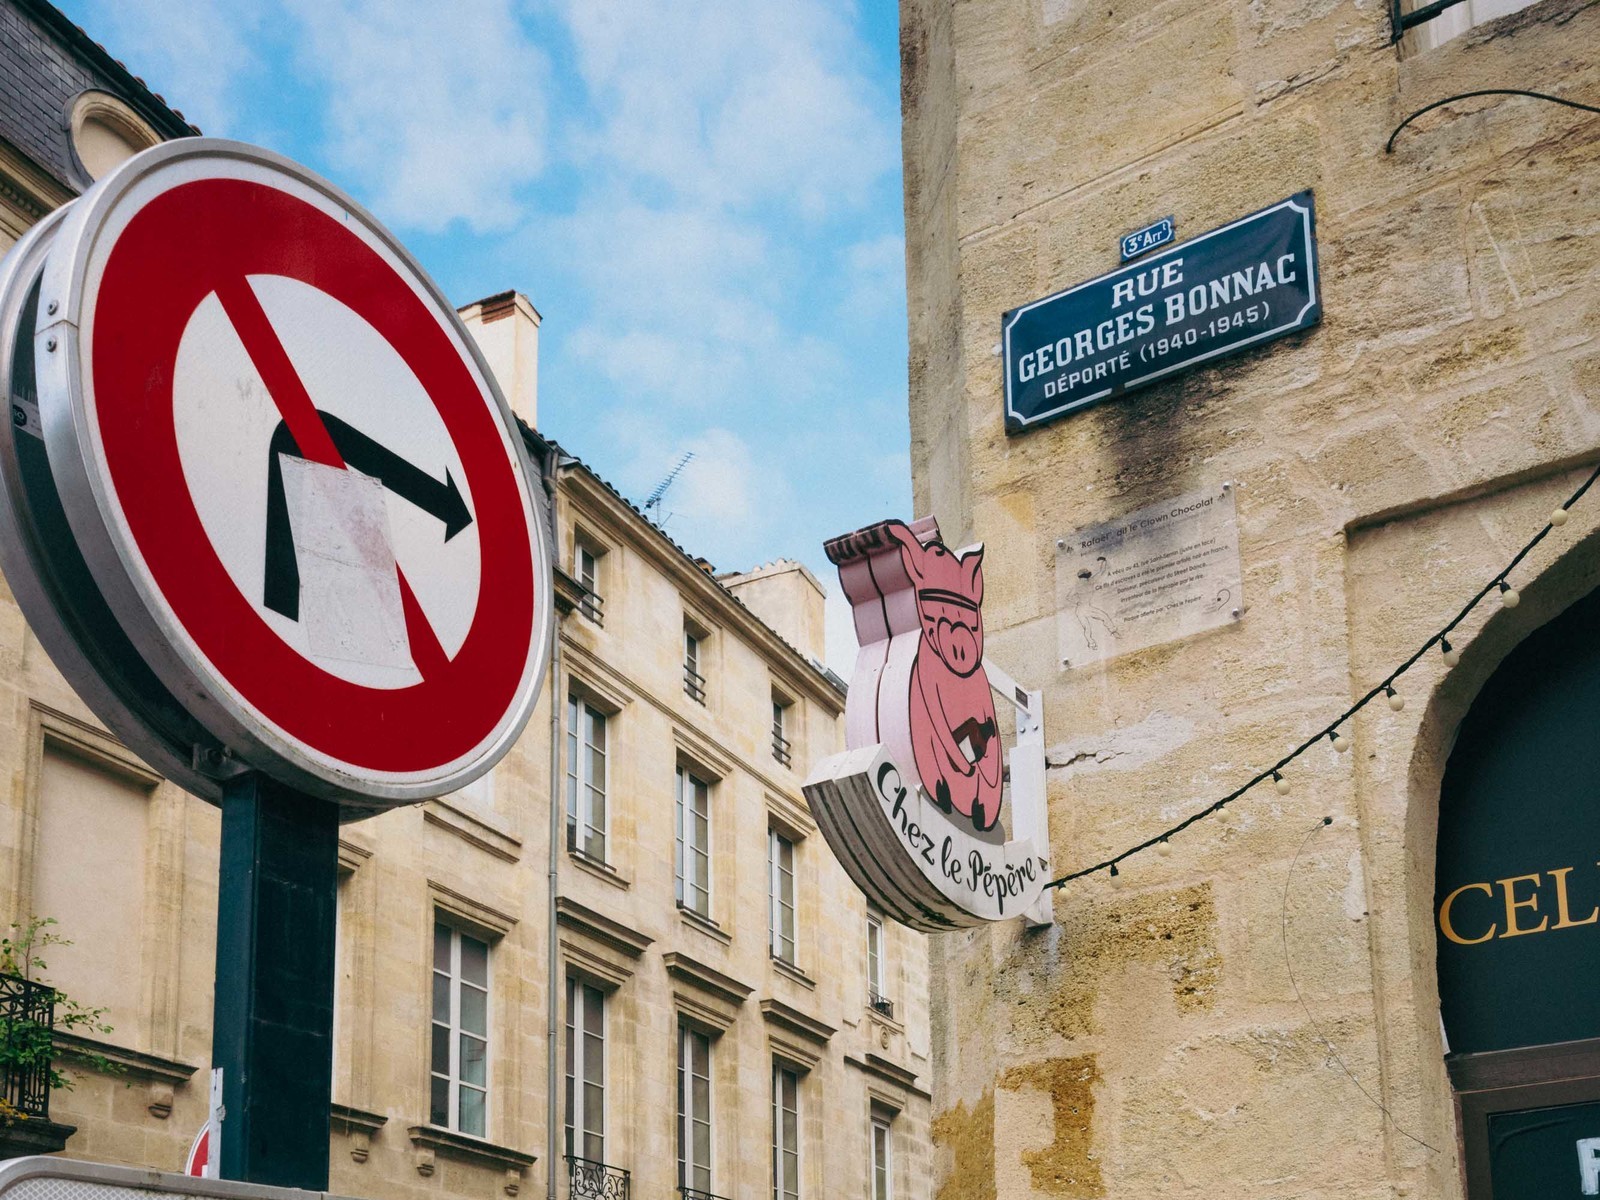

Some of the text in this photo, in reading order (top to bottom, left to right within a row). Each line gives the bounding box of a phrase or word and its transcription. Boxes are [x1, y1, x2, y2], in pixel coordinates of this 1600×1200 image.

[1018, 253, 1296, 383] GEORGES BONNAC
[1111, 258, 1184, 309] RUE
[1044, 301, 1270, 399] DÉPORTÉ (1940-1945)
[1140, 514, 1168, 528] Clown
[1171, 496, 1214, 518] Chocolat
[877, 762, 1036, 915] Chez le Pépère
[1440, 862, 1600, 945] CEL
